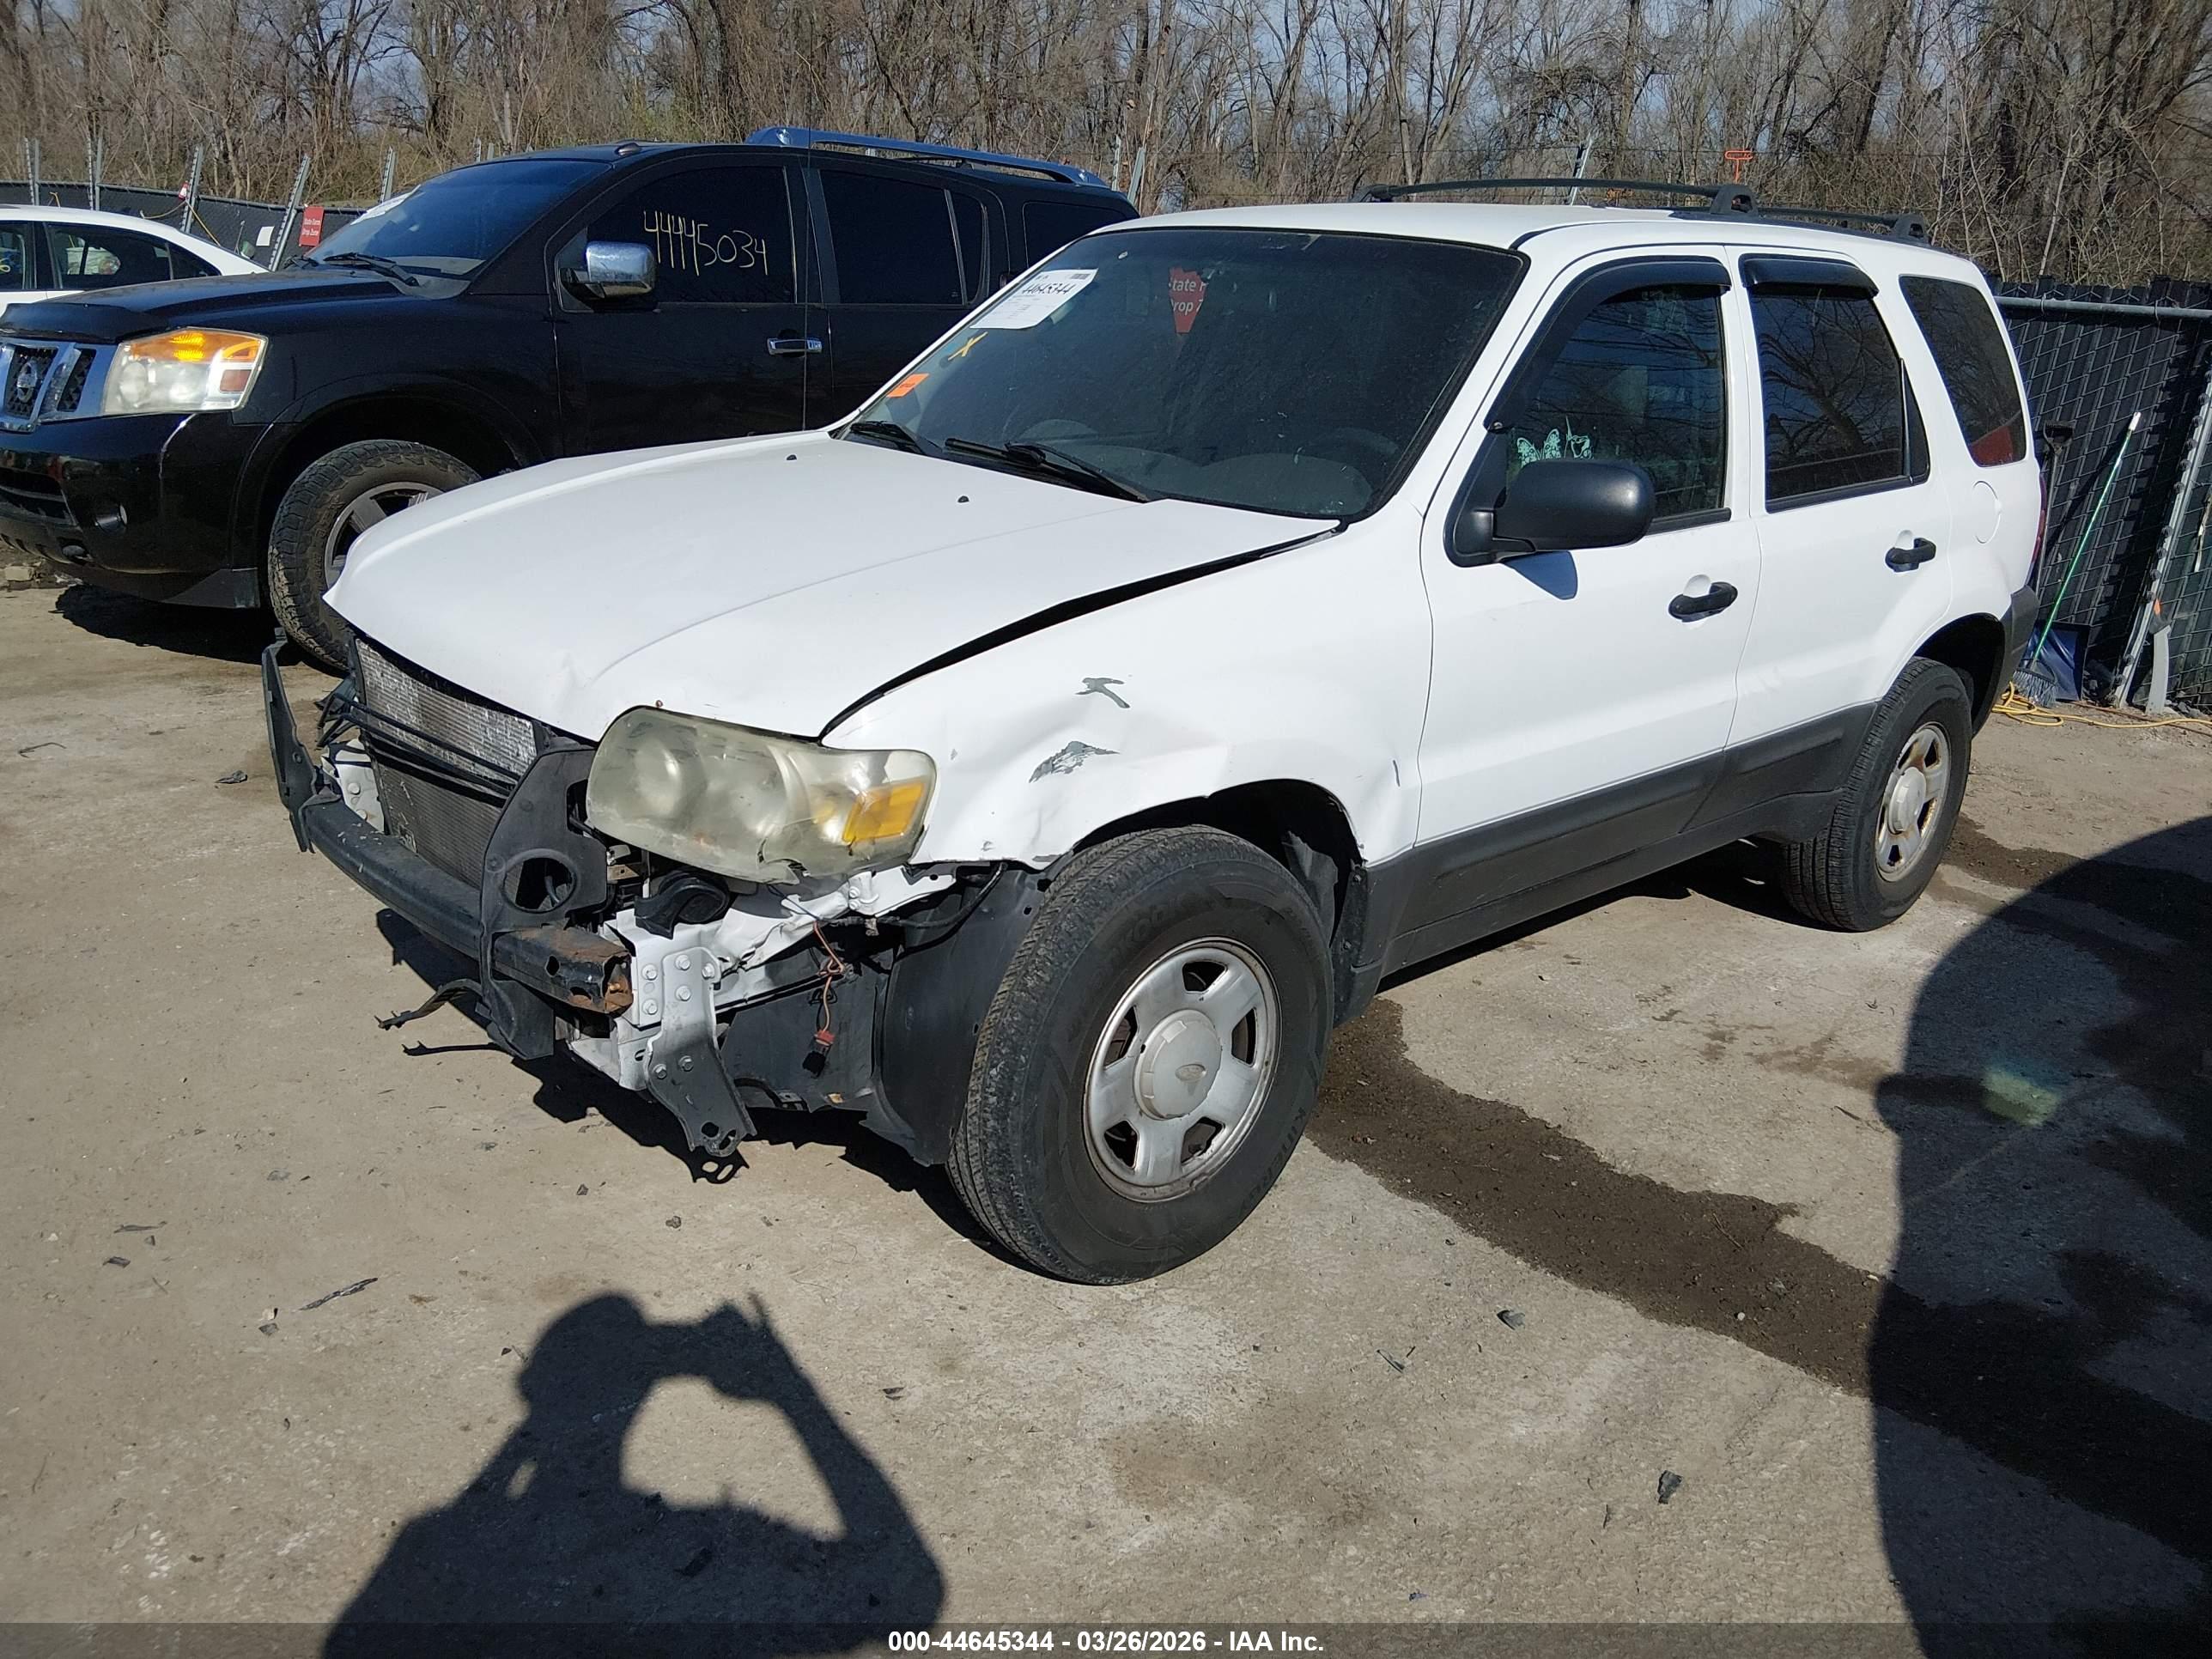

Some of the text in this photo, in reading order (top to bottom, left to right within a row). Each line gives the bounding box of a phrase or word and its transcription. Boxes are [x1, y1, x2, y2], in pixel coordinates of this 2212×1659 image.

[643, 210, 769, 276] 44445034
[1169, 278, 1196, 292] tate
[1170, 298, 1194, 316] rop
